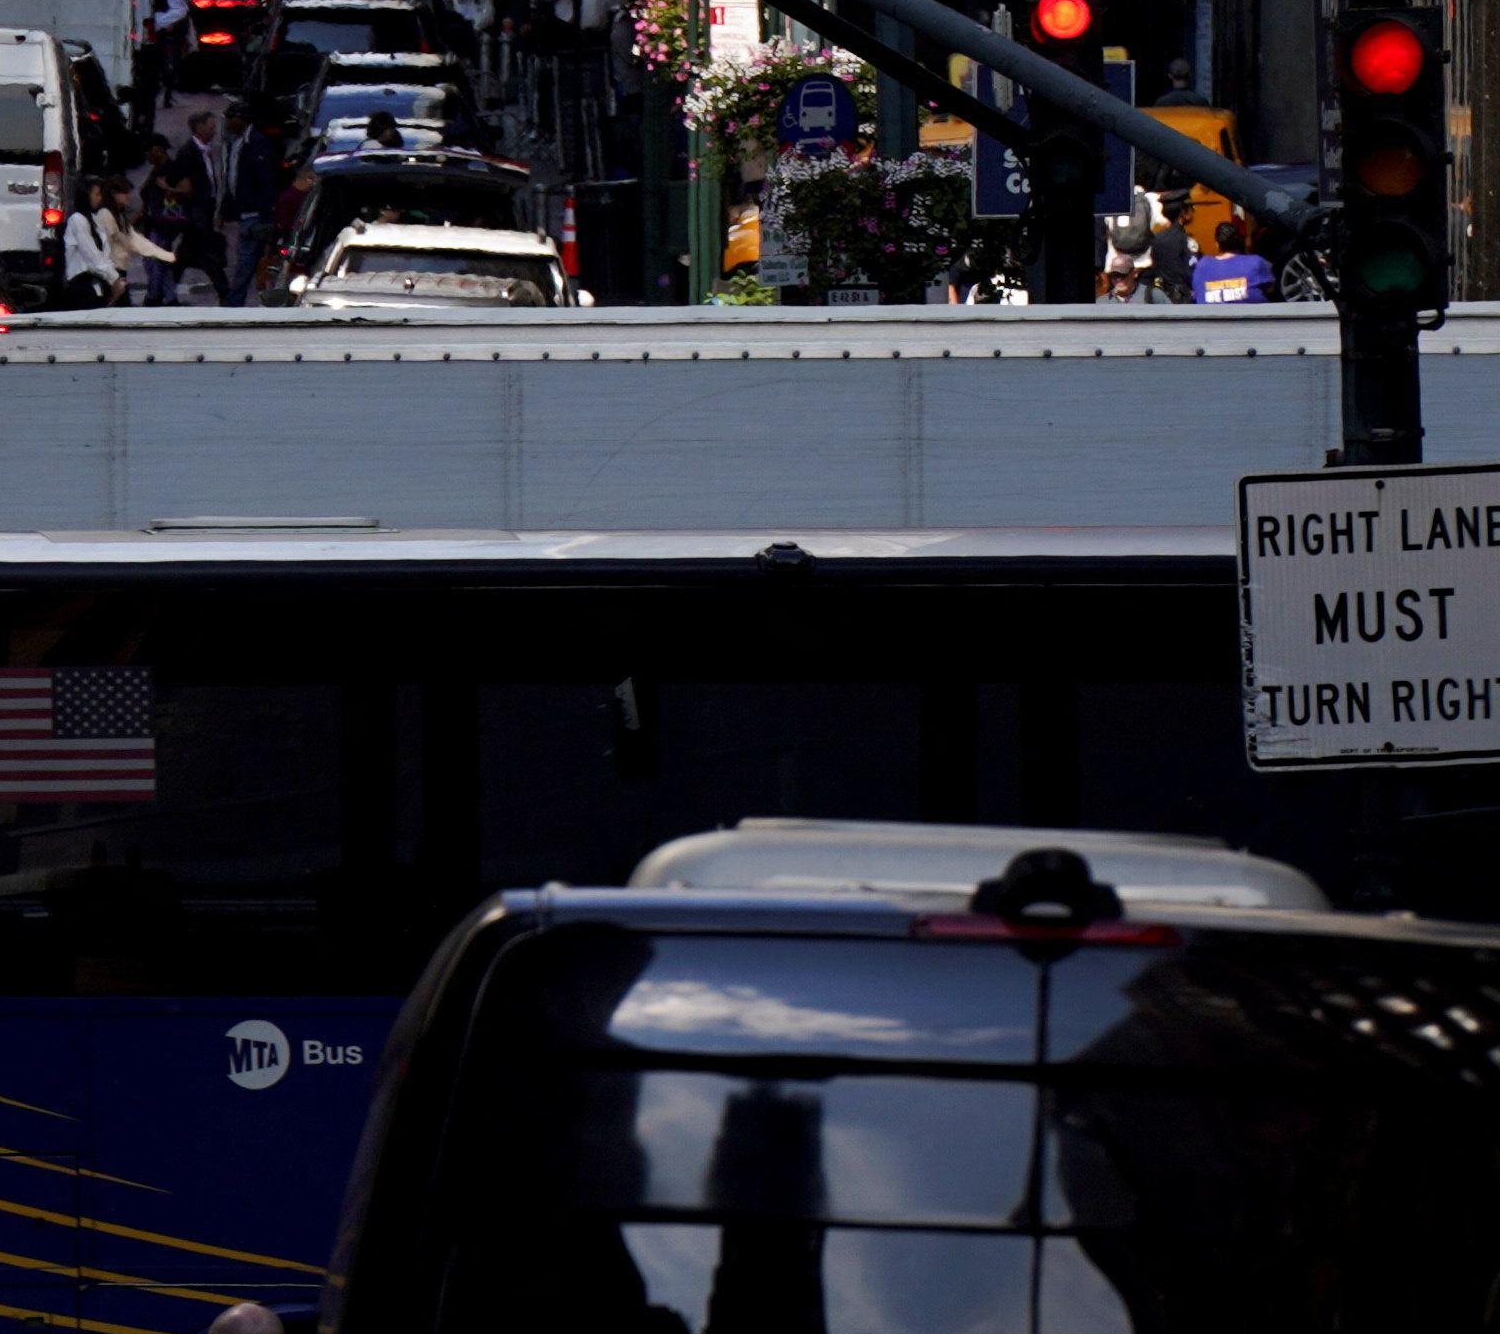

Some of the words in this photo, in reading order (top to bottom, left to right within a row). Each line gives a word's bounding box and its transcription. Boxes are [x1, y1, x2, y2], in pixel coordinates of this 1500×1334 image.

[1257, 510, 1380, 557] RIGHT
[1314, 587, 1455, 645] MUST
[1261, 681, 1371, 727] TURN
[227, 1036, 279, 1075] MTA
[301, 1039, 364, 1066] Bus
